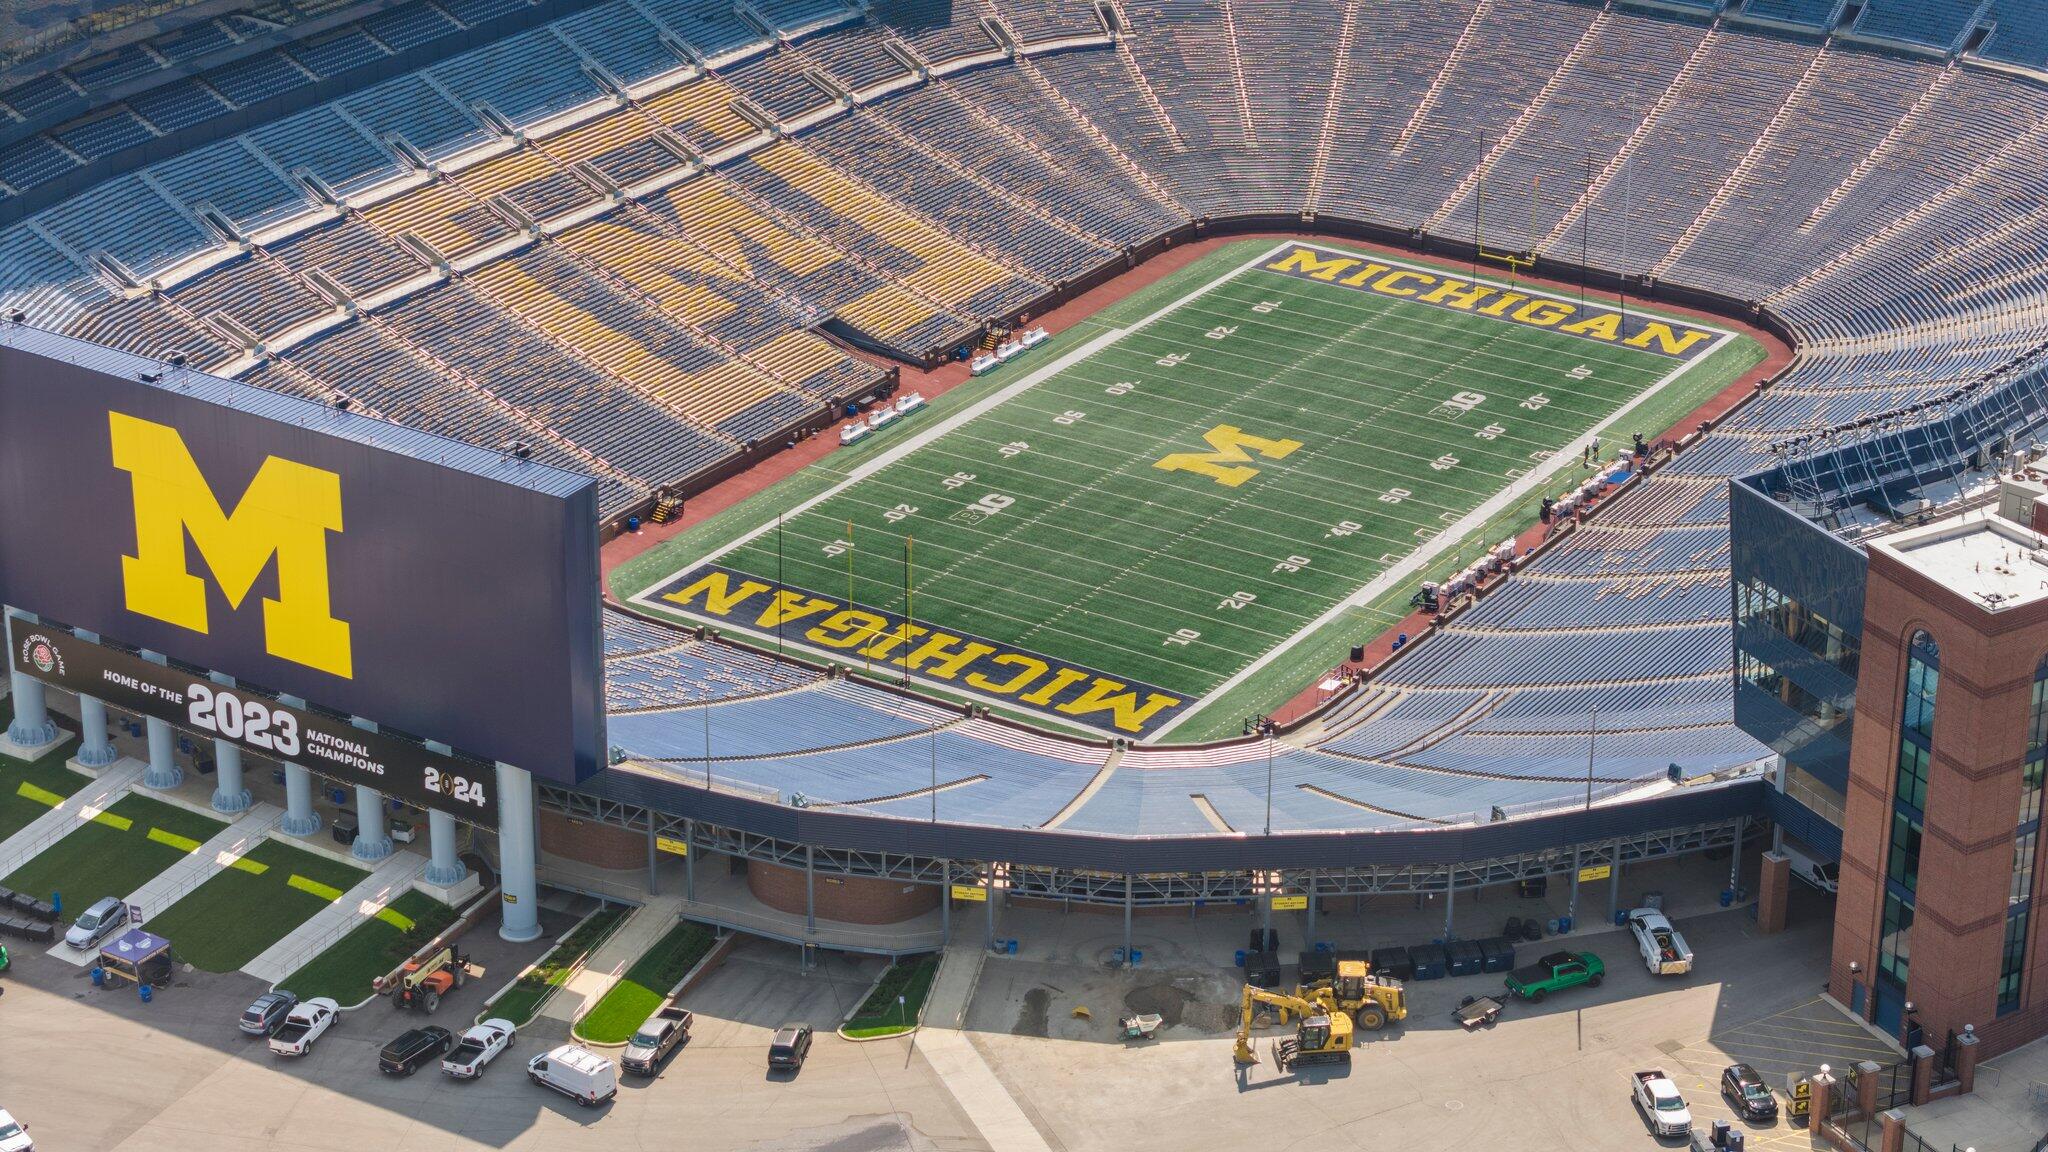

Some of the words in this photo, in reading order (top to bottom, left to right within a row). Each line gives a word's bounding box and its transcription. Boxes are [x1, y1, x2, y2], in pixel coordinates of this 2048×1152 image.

[1251, 301, 1280, 313] 10
[1266, 248, 1713, 357] MICHIGAN
[1204, 326, 1236, 339] 20
[1155, 353, 1188, 366] 30
[1565, 367, 1593, 380] 10
[1105, 382, 1134, 395] 40
[1519, 396, 1550, 410] 20
[1052, 410, 1086, 424] 50
[1474, 425, 1506, 440] 30
[999, 441, 1029, 455] 40
[1151, 424, 1304, 487] M
[1430, 456, 1460, 470] 40
[942, 472, 976, 487] 30
[1378, 488, 1411, 503] 50
[883, 504, 919, 520] 20
[1331, 521, 1362, 536] 40
[109, 410, 352, 679] M
[822, 540, 855, 554] 10
[1276, 555, 1311, 572] 30
[1220, 591, 1256, 609] 20
[1167, 628, 1201, 645] 10
[22, 639, 31, 663] ROSE
[30, 634, 52, 648] BOWL
[52, 646, 66, 676] GAME
[662, 571, 1182, 733] MICHIGAN
[103, 669, 138, 690] HOME
[140, 681, 157, 695] OF
[159, 688, 183, 705] THE
[187, 683, 301, 756] 2023
[306, 728, 370, 758] NATIONAL
[307, 743, 385, 776] CHAMPIONS
